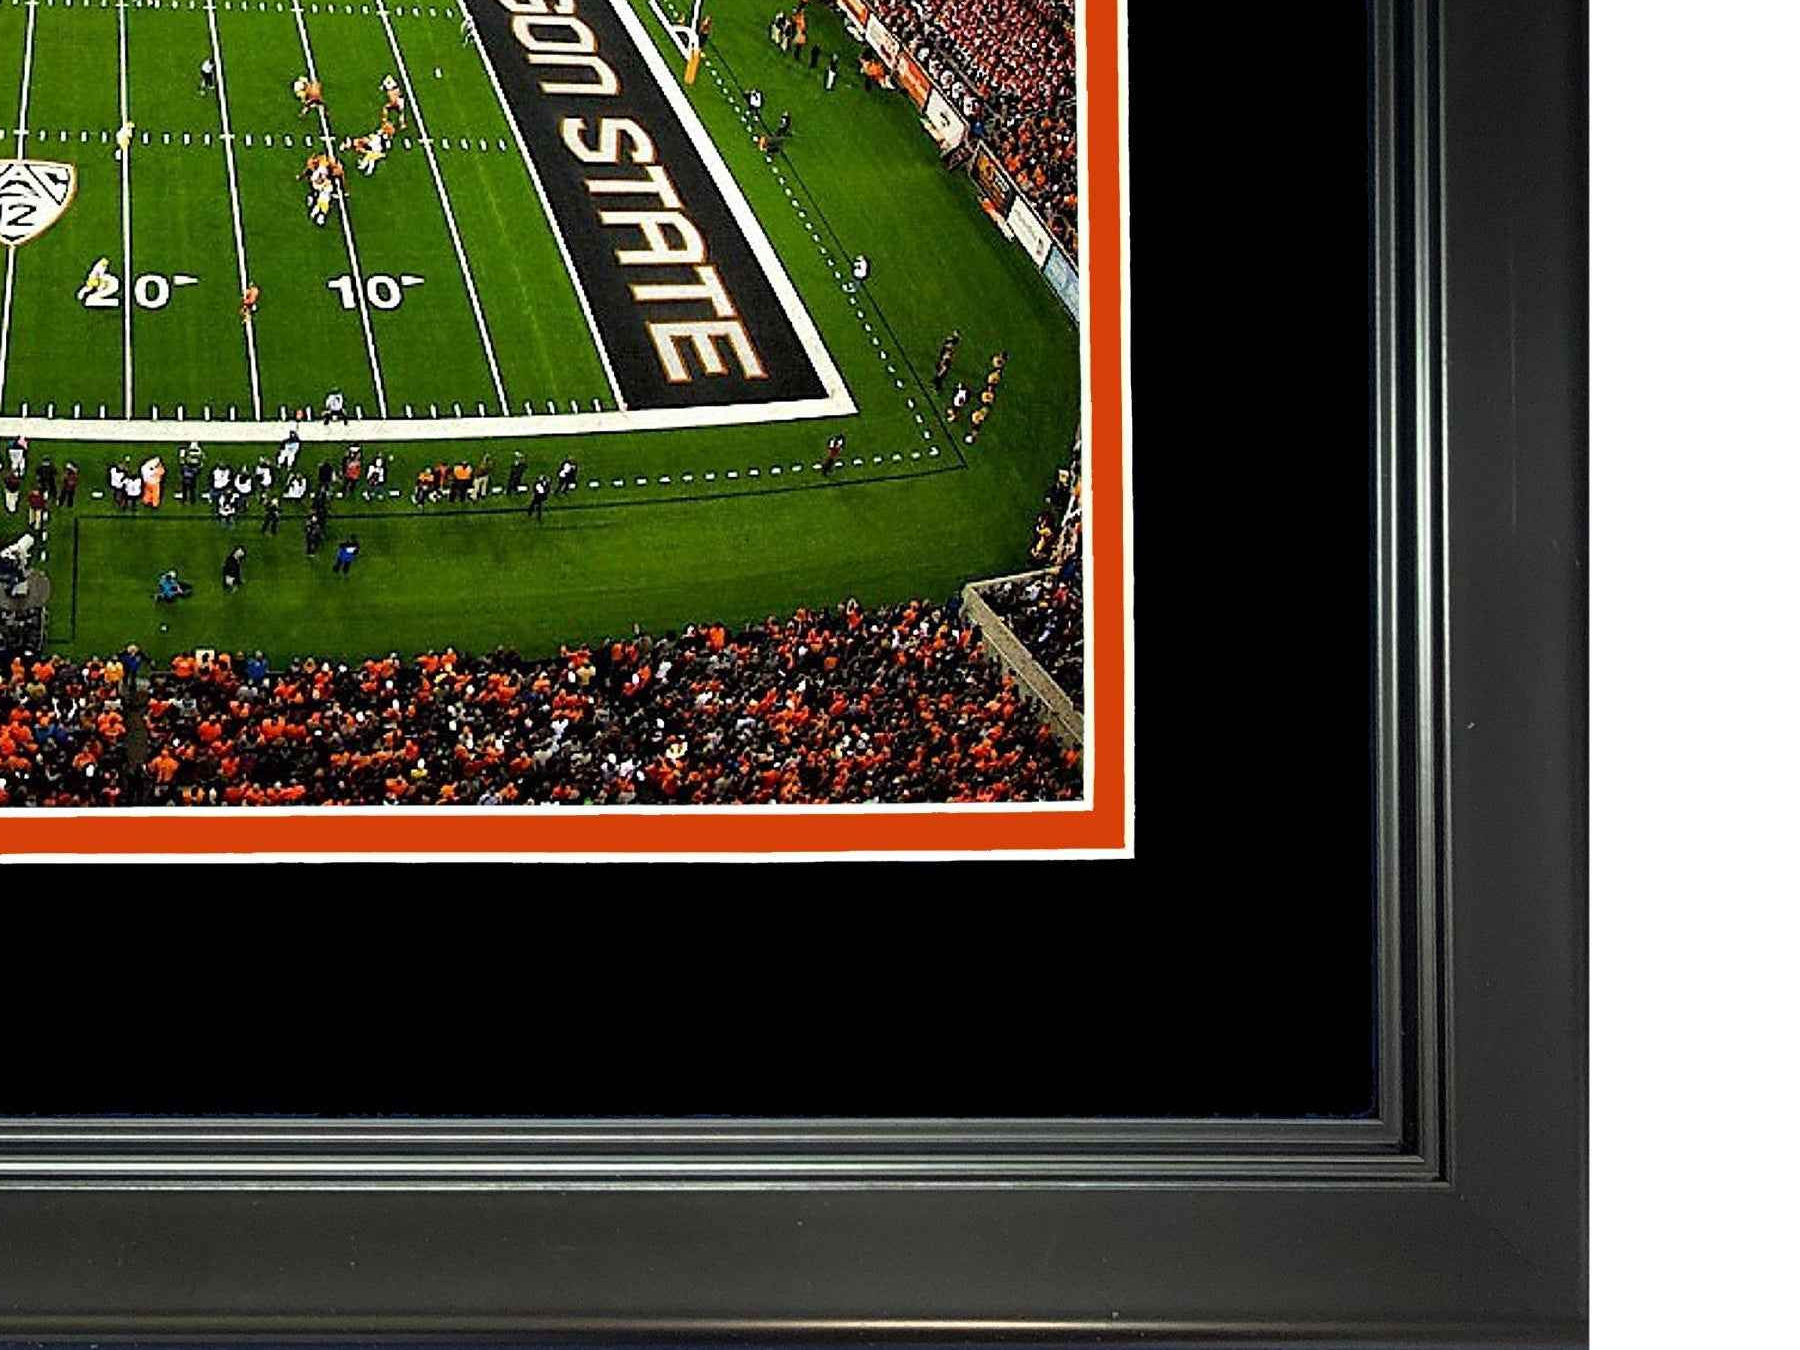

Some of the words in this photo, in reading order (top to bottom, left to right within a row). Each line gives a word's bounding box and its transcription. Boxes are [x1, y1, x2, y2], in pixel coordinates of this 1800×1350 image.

[560, 115, 771, 384] STATE
[83, 273, 170, 309] 20
[327, 274, 402, 310] 10
